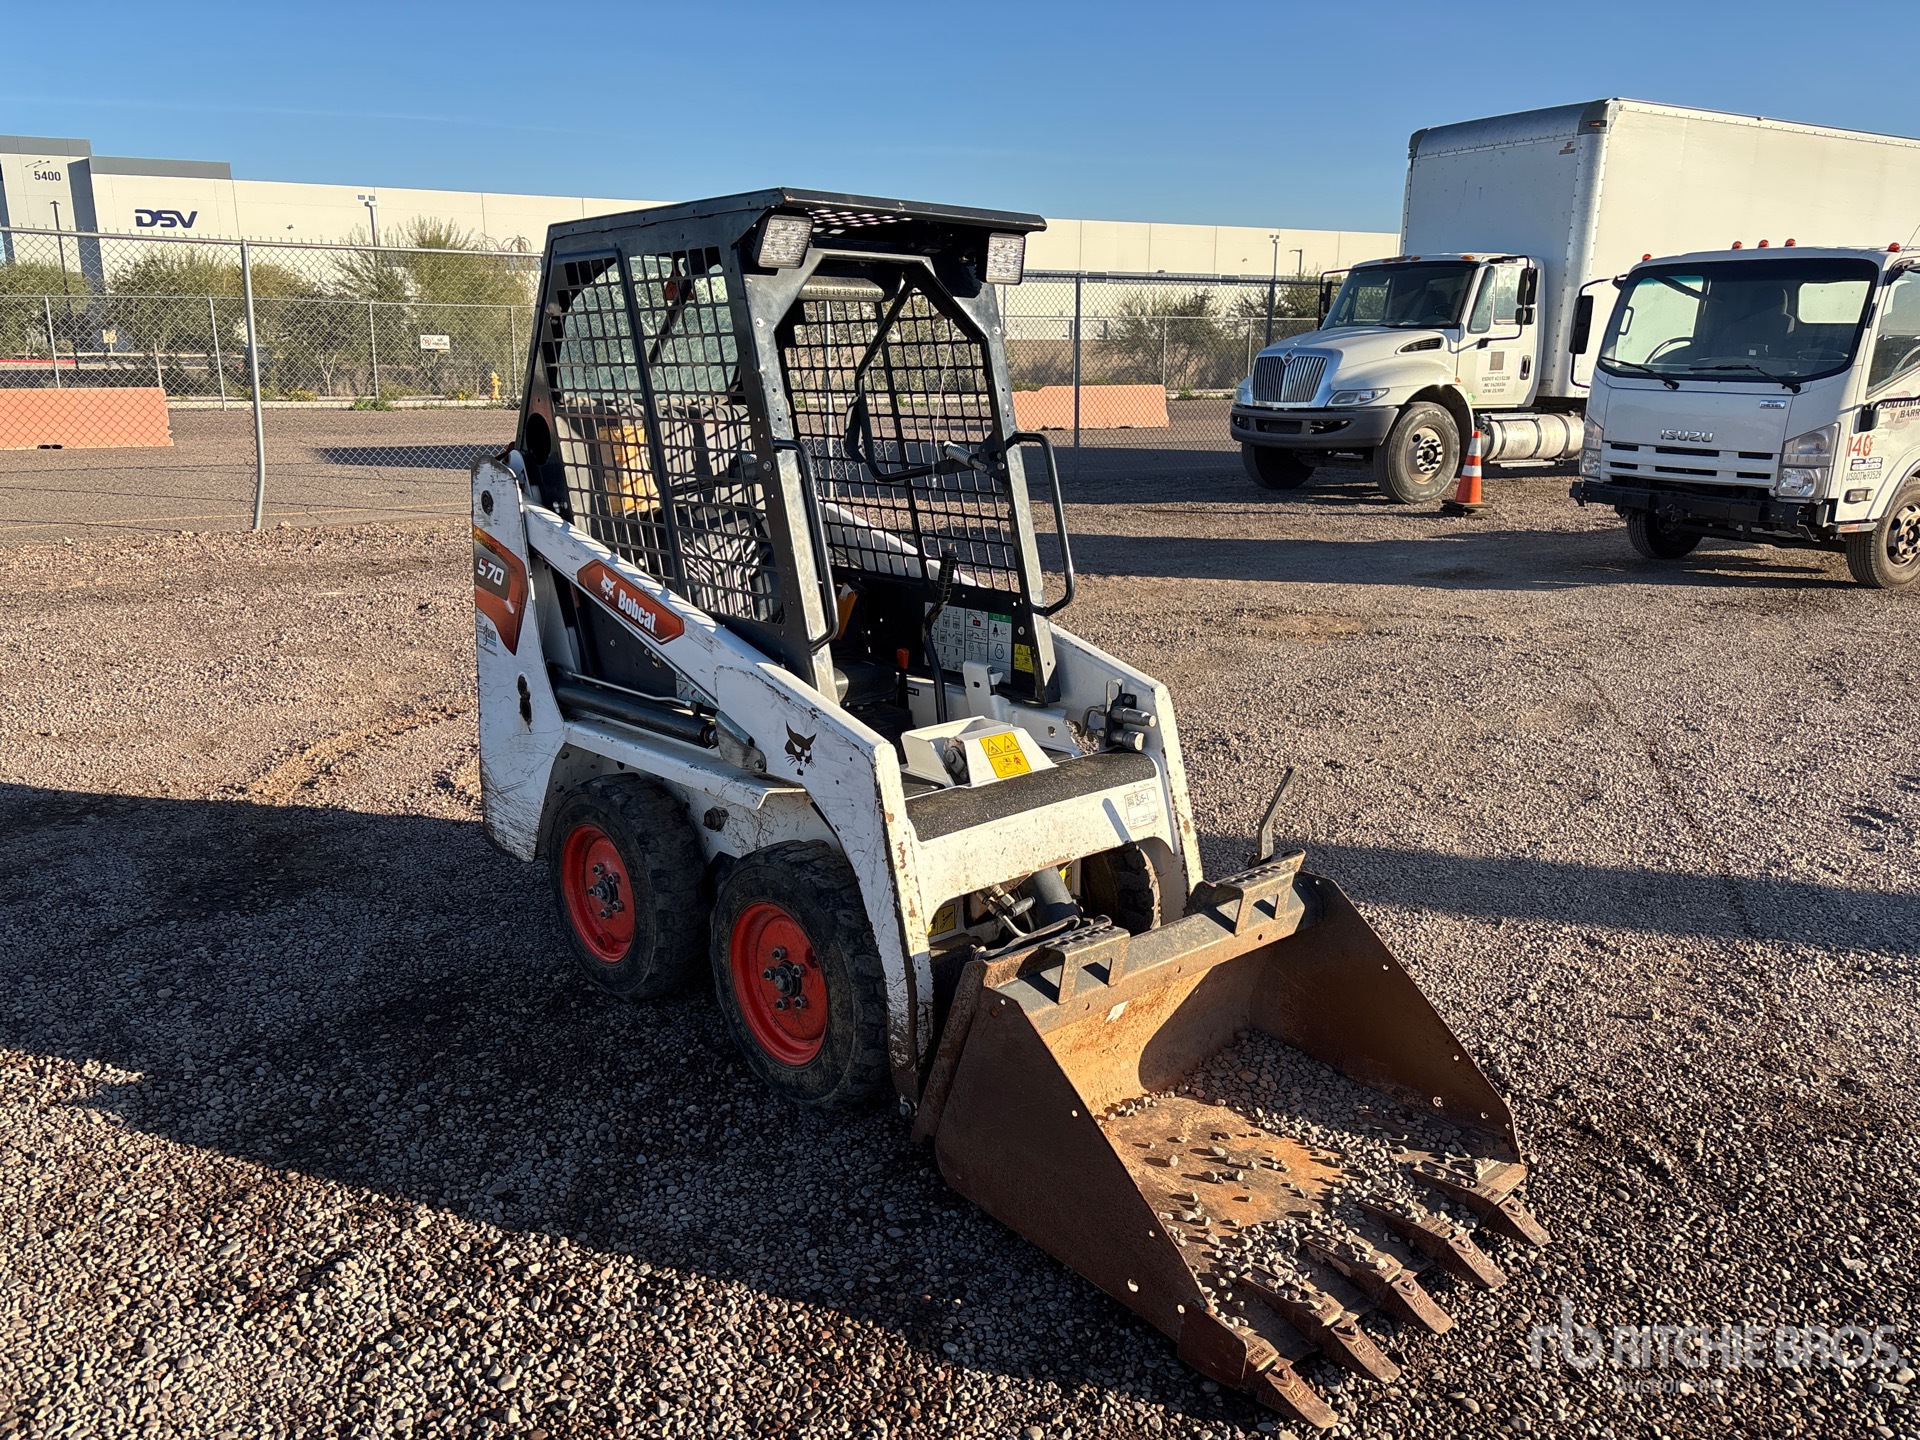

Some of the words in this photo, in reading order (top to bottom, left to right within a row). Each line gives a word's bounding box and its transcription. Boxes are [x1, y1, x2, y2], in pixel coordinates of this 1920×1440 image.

[34, 171, 61, 181] 5400
[134, 209, 198, 228] DSV
[808, 287, 829, 296] BELT
[832, 288, 852, 297] SEAT
[1660, 429, 1714, 443] ISUZU
[477, 557, 505, 586] S70
[617, 588, 656, 632] Bobcat
